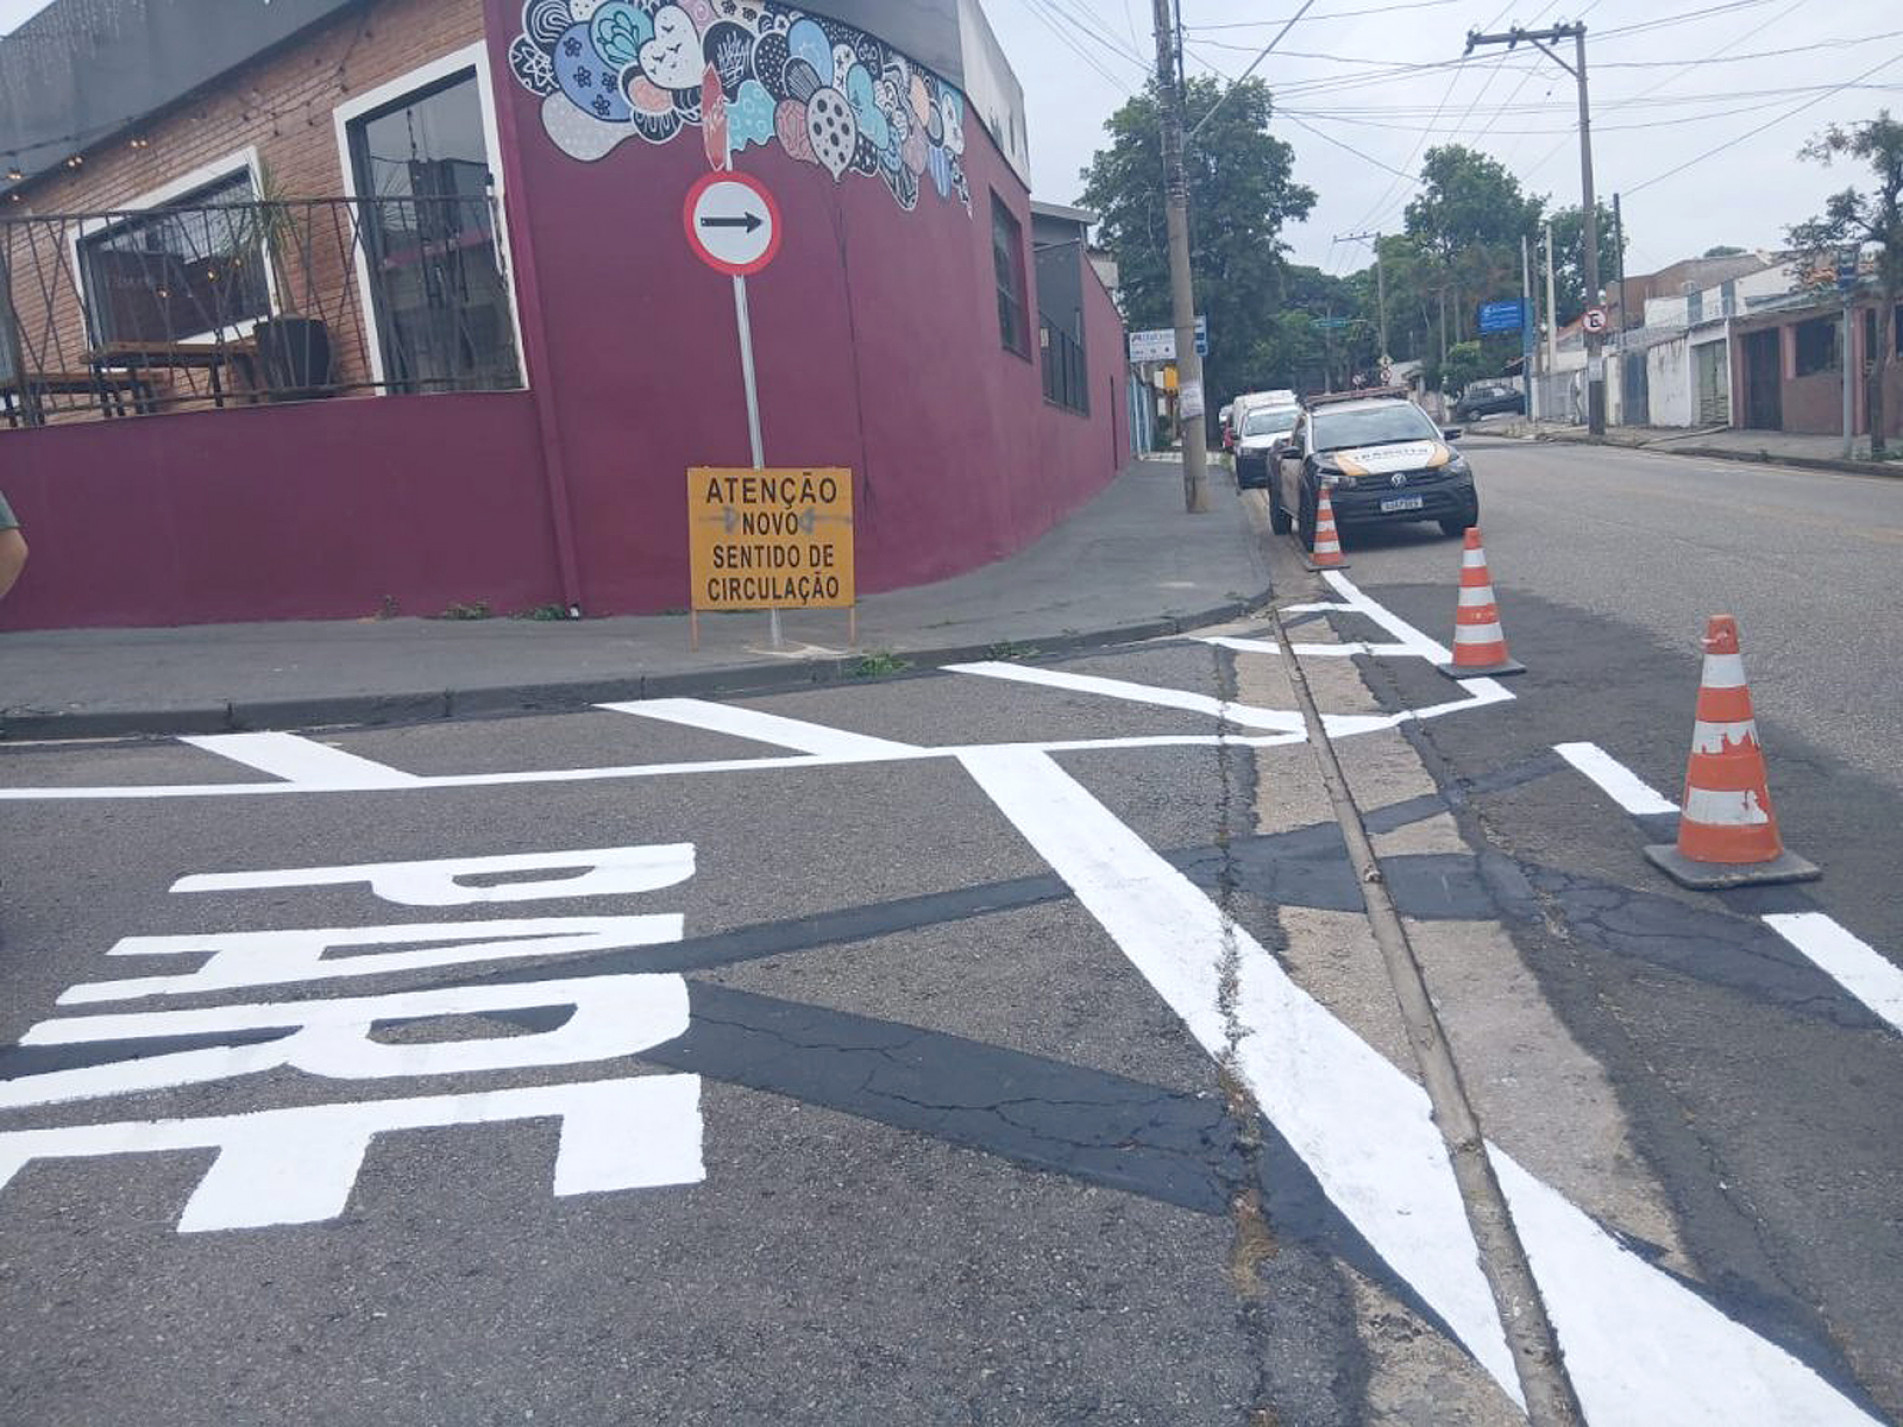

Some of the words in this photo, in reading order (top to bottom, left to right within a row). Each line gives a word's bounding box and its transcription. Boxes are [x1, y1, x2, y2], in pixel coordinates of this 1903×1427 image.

[1590, 313, 1602, 327] E
[706, 472, 837, 510] ATENÇÃO
[742, 511, 799, 535] NOVO
[713, 545, 800, 569] SENTIDO
[809, 544, 834, 568] DE
[707, 571, 839, 605] CIRCULAÇÃO
[0, 842, 707, 1233] PARE
